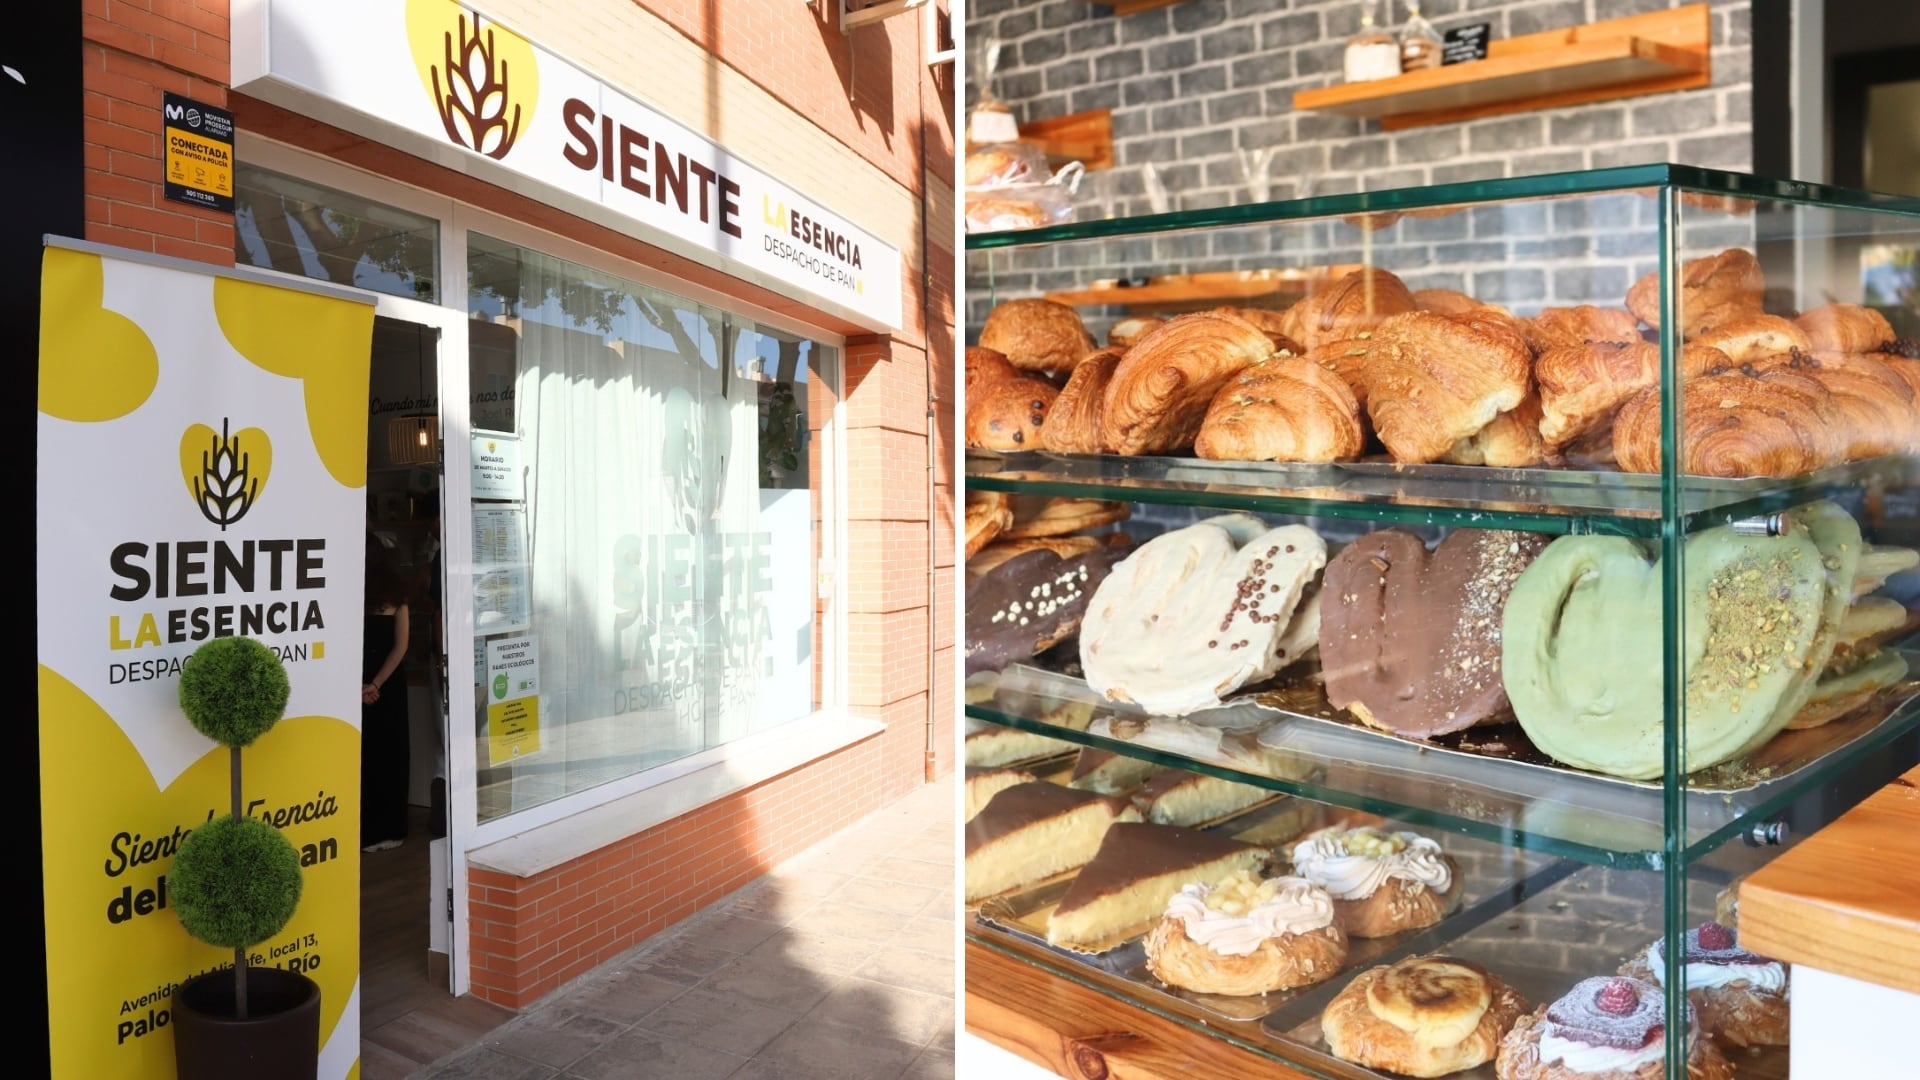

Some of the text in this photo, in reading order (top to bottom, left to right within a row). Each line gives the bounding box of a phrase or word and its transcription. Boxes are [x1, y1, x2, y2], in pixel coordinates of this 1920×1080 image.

[205, 113, 231, 125] MOVISTAR
[205, 119, 233, 132] PROSEGUR
[205, 126, 227, 137] ALARMAS
[171, 136, 228, 160] CONECTADA
[171, 147, 184, 155] CON
[185, 151, 202, 160] AVISO
[208, 157, 228, 168] POLICÍA
[562, 97, 742, 240] SIENTE
[763, 192, 863, 271] LA ESENCIA
[764, 234, 856, 292] DESPACHO DE PAN
[372, 394, 415, 416] Cuando
[480, 455, 504, 464] HORARIO
[110, 538, 326, 602] SIENTE
[110, 600, 325, 650] LA ESENCIA
[496, 643, 520, 651] PREGUNTA
[502, 651, 525, 659] NUESTROS
[508, 658, 534, 668] ECOLÓGICOS
[107, 875, 166, 925] del
[120, 981, 180, 1016] Avenida
[269, 937, 300, 960] local
[303, 932, 319, 947] 13,
